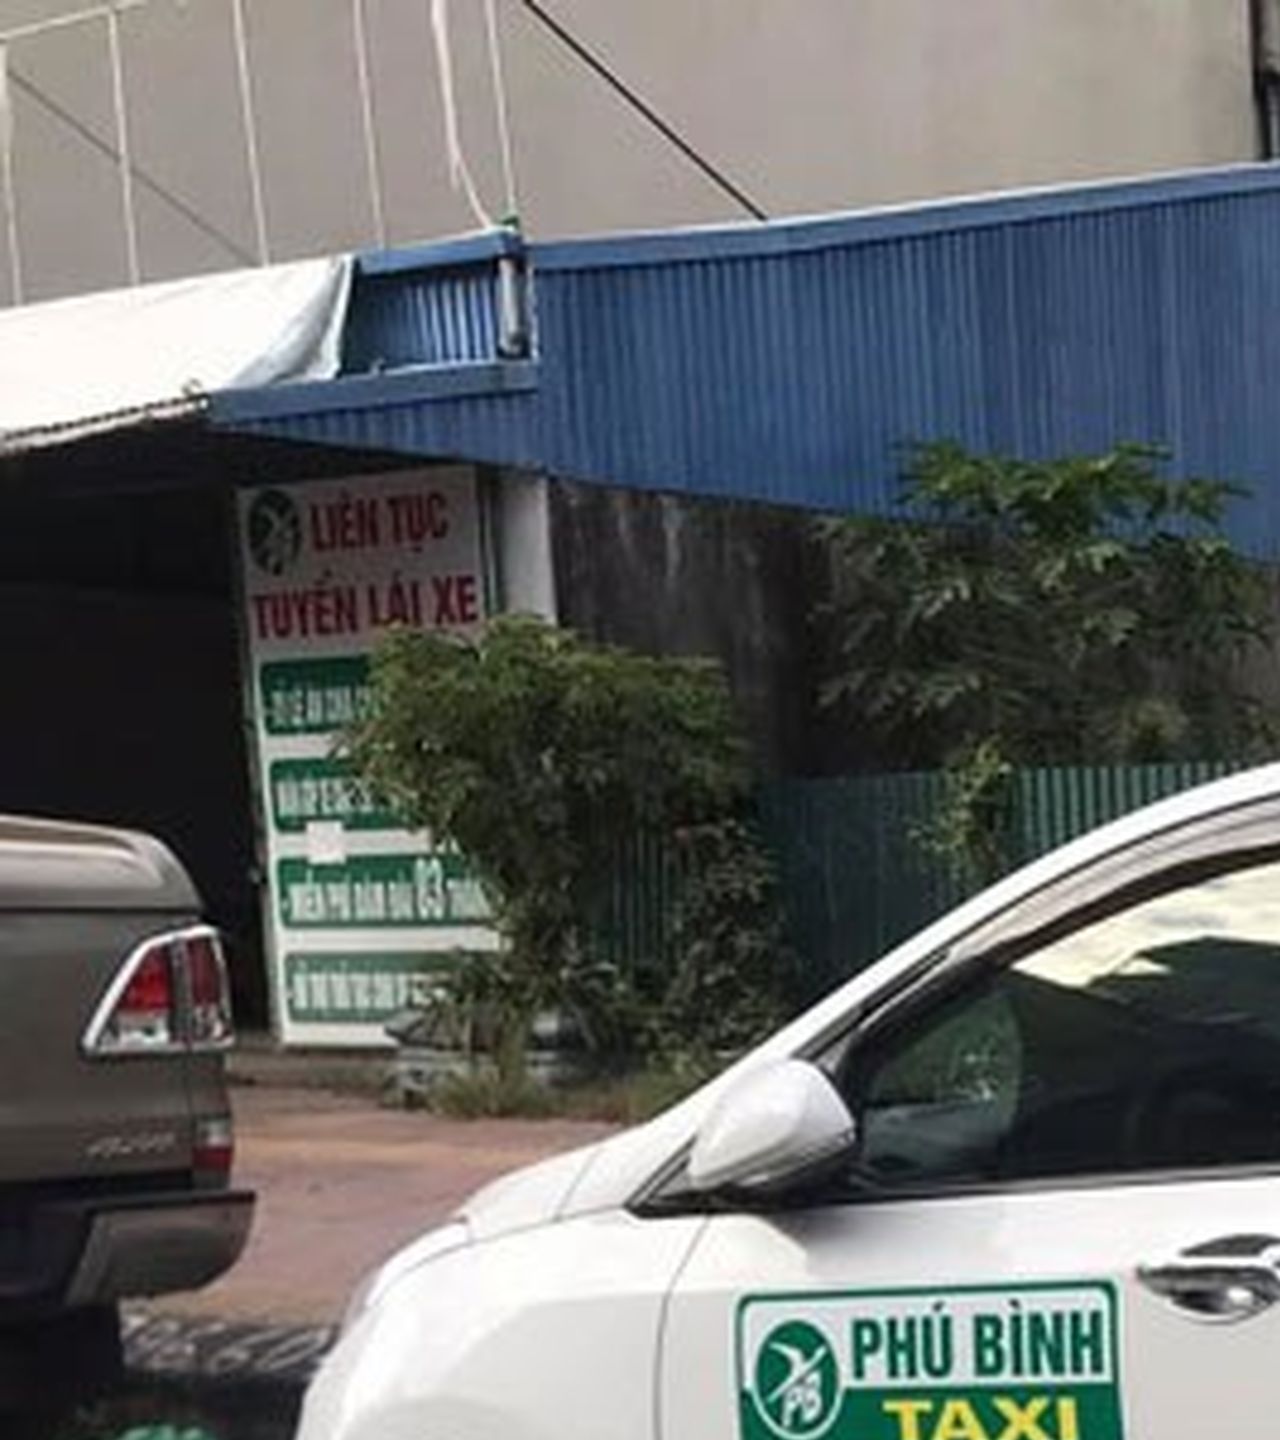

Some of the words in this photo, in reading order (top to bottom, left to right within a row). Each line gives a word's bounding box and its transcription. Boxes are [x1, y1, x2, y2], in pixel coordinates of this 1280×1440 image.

[386, 490, 449, 553] TỤC
[432, 574, 478, 625] XE
[850, 1301, 953, 1380] PHÚ
[973, 1299, 1104, 1377] BÌNH
